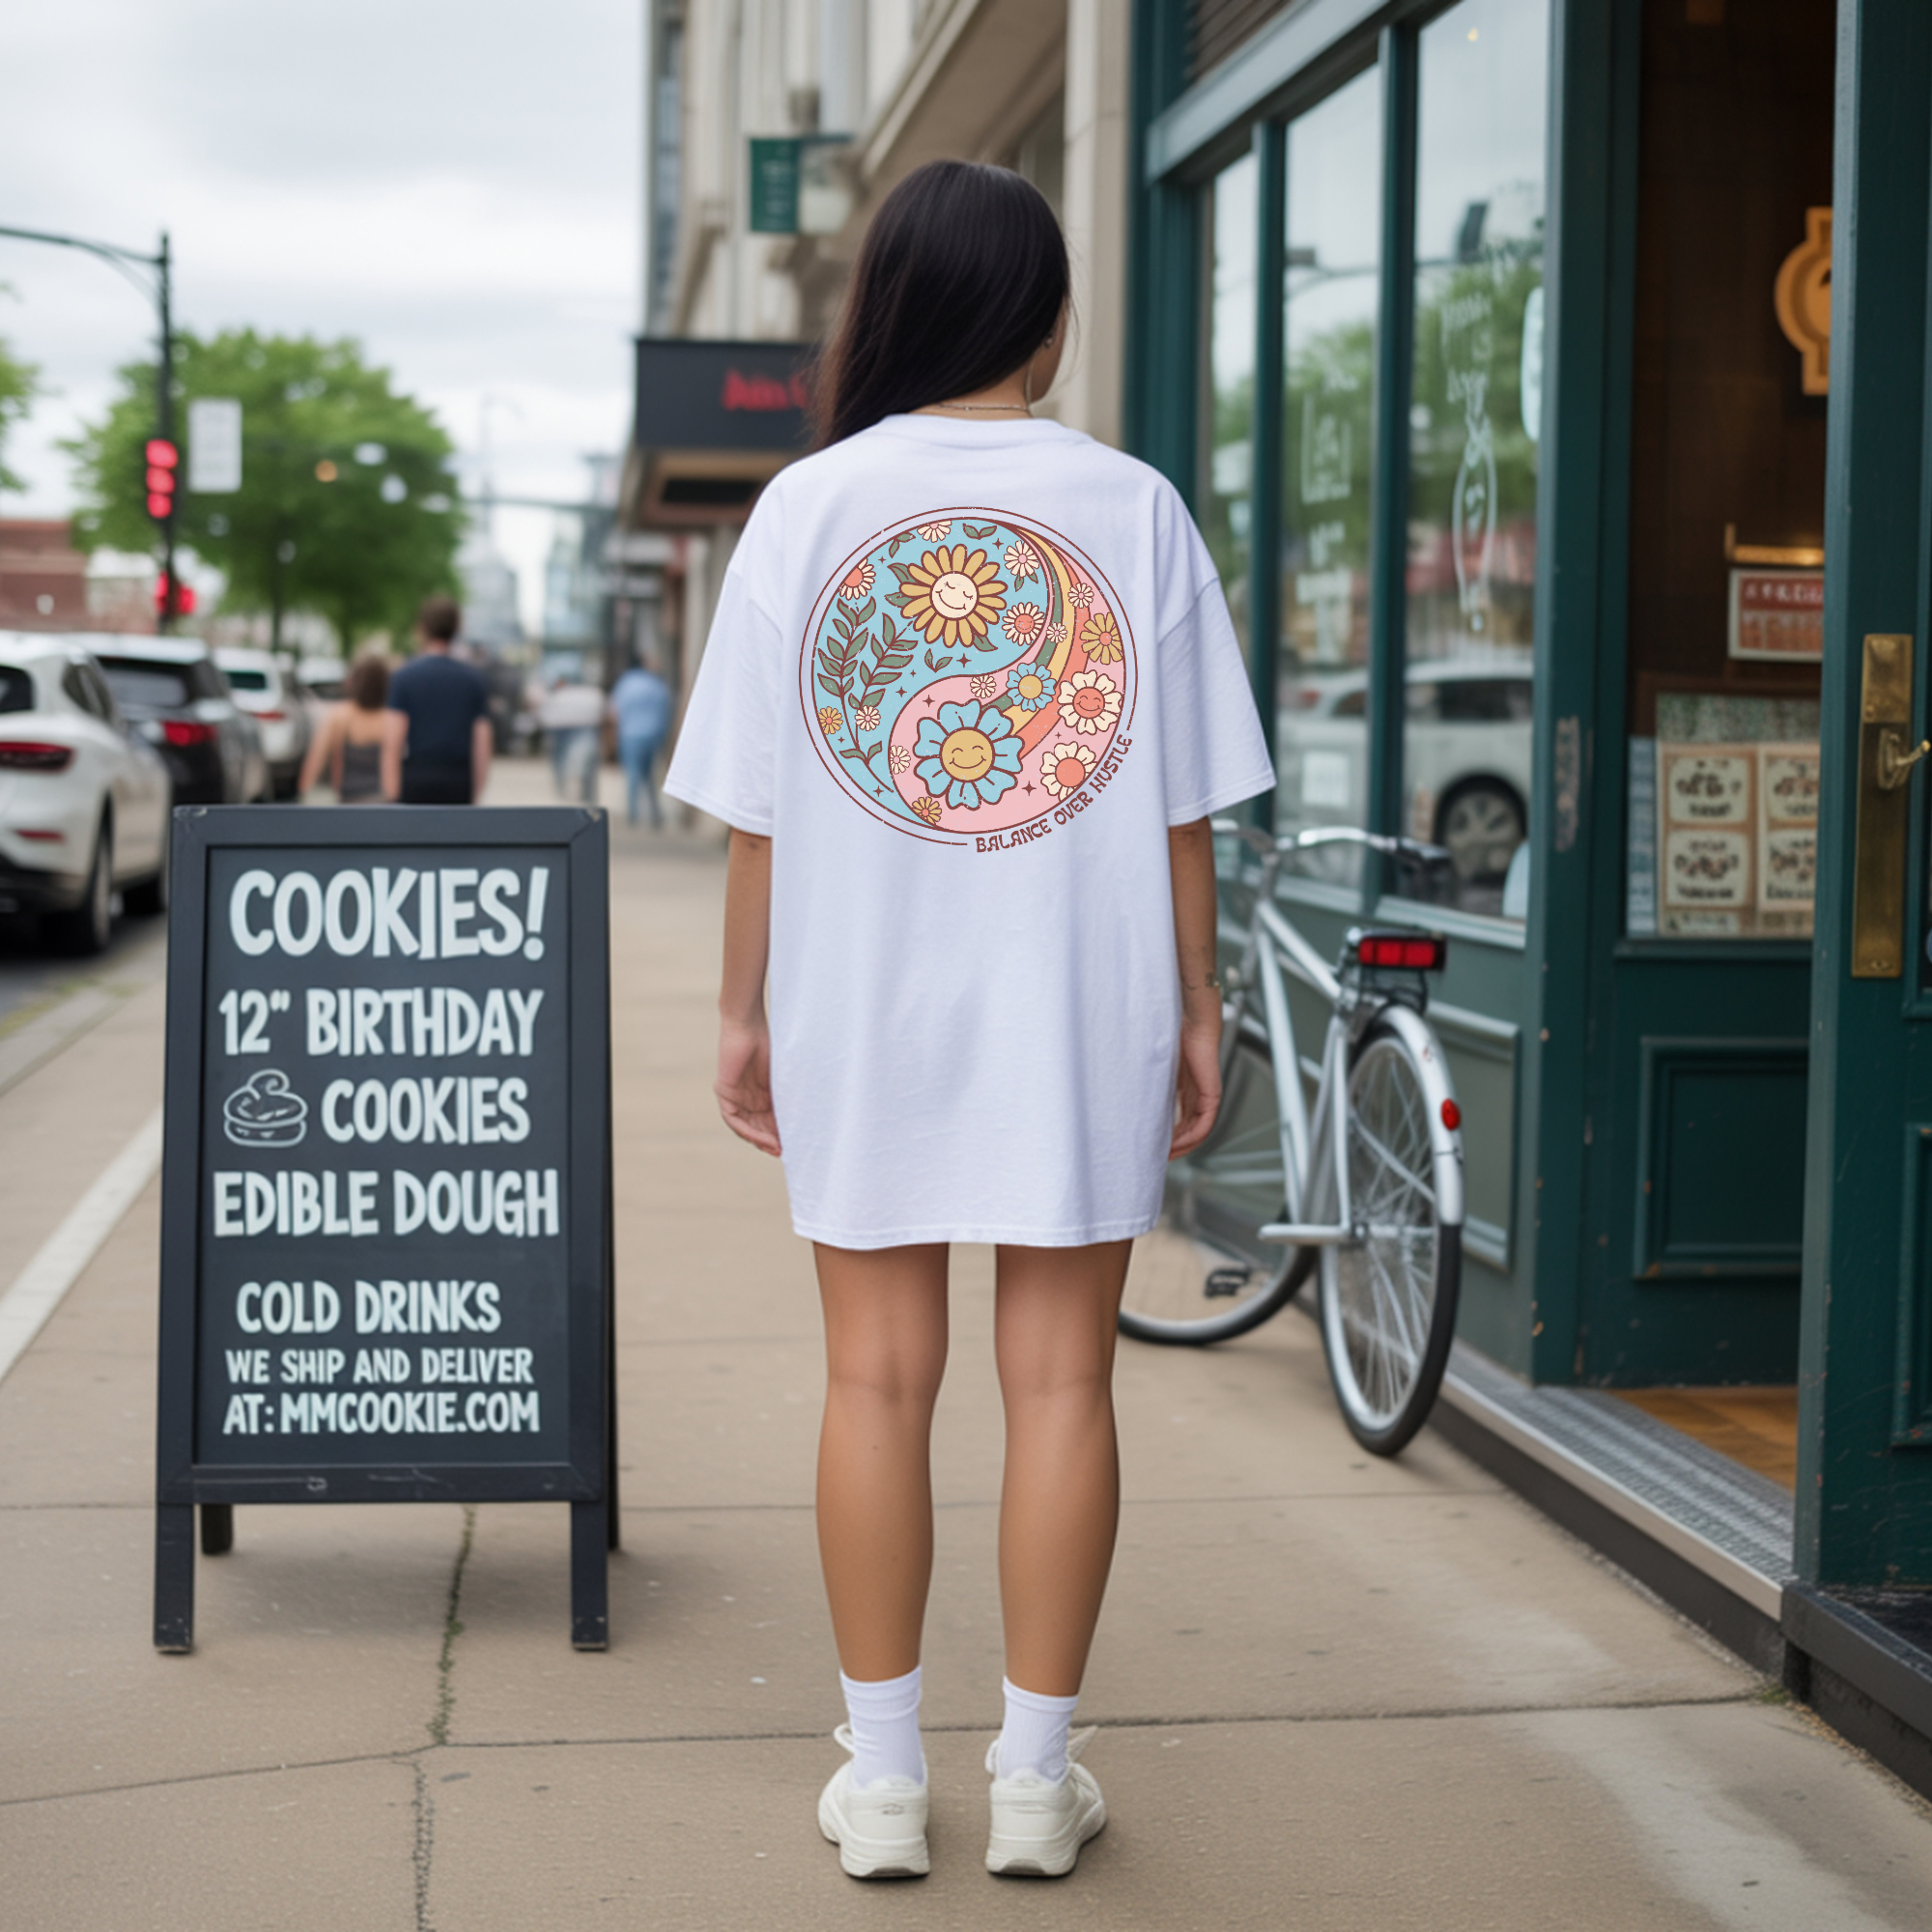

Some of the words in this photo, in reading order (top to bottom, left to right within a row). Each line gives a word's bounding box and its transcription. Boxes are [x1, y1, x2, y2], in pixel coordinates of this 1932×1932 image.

[976, 818, 1052, 852] BALANCE
[1054, 792, 1093, 824] OVER
[1090, 734, 1132, 793] HUSTLE
[230, 867, 549, 960] COOKIES!
[218, 989, 291, 1055] 12"
[306, 987, 544, 1057] BIRTHDAY
[322, 1076, 530, 1145] COOKIES
[213, 1170, 379, 1236] EDIBLE
[393, 1169, 559, 1237] DOUGH
[237, 1281, 340, 1334] COLD
[355, 1280, 501, 1333] DRINKS
[225, 1349, 270, 1384] WE
[280, 1349, 345, 1383] SHIP
[353, 1348, 411, 1383] AND
[421, 1348, 533, 1383] DELIVER
[281, 1391, 539, 1434] MMCOOKIE.COM
